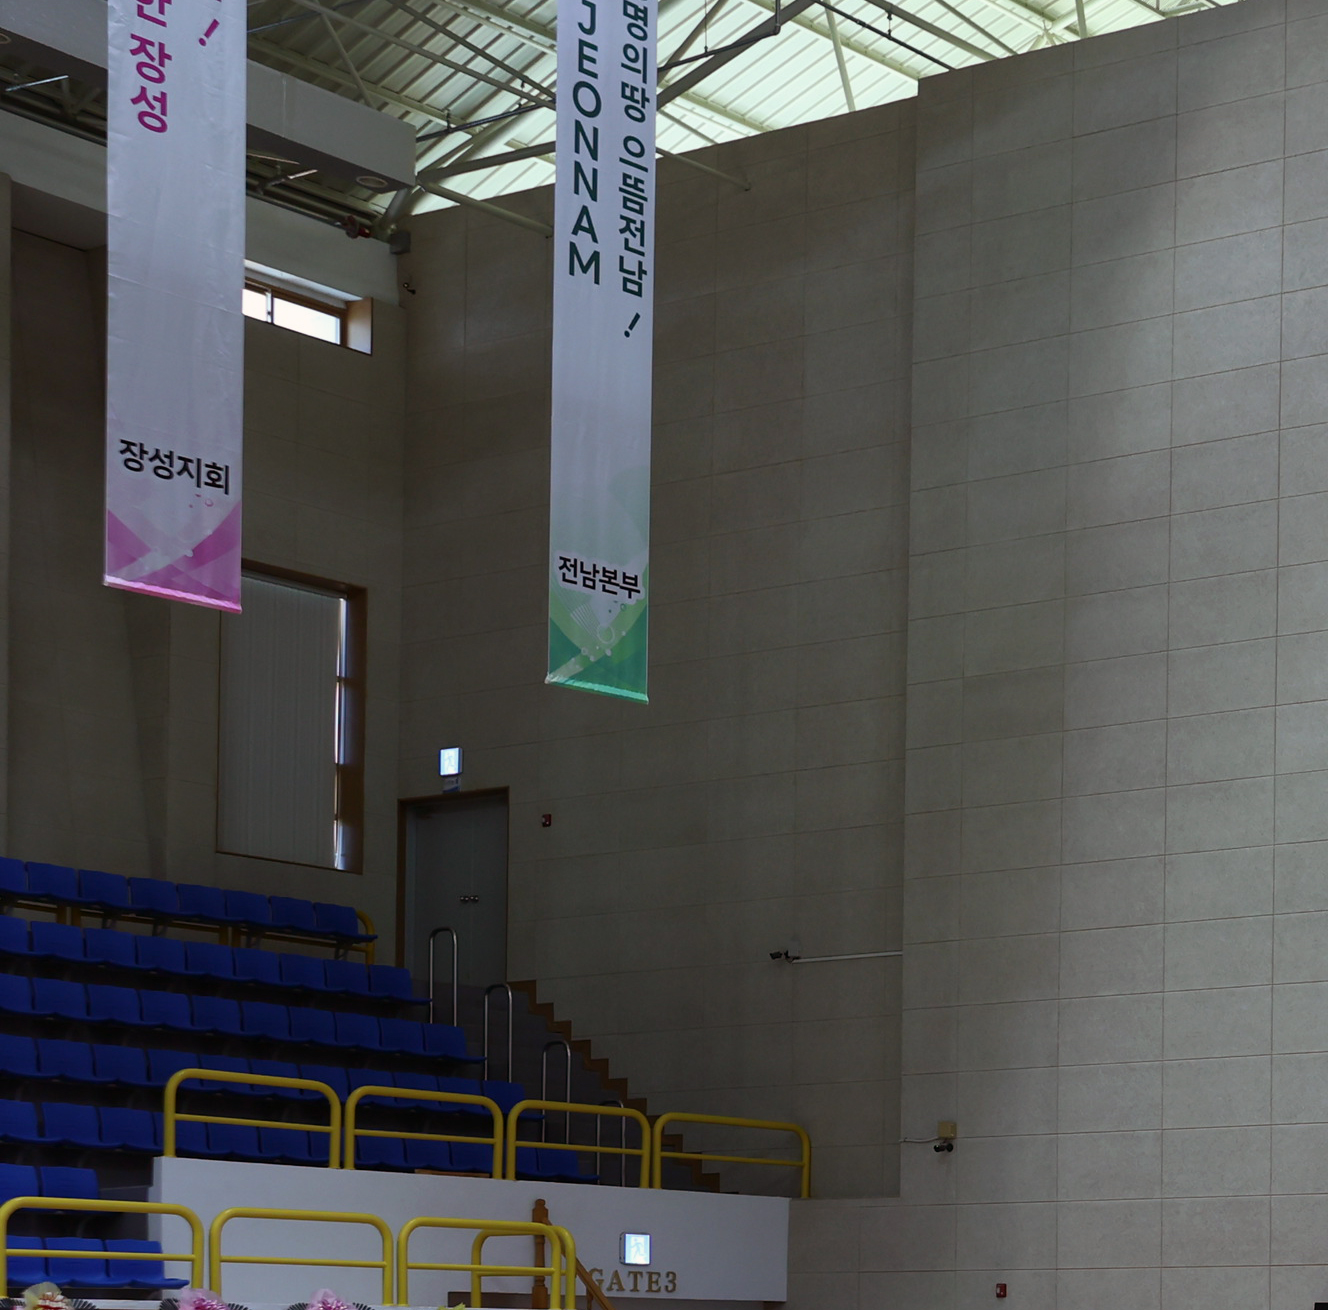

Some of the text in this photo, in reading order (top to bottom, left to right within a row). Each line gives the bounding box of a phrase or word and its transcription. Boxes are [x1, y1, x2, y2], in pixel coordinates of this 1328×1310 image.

[129, 32, 173, 133] 장성
[568, 0, 602, 286] JEONNAM
[118, 438, 232, 496] 장성지회
[557, 554, 643, 600] 전남본부
